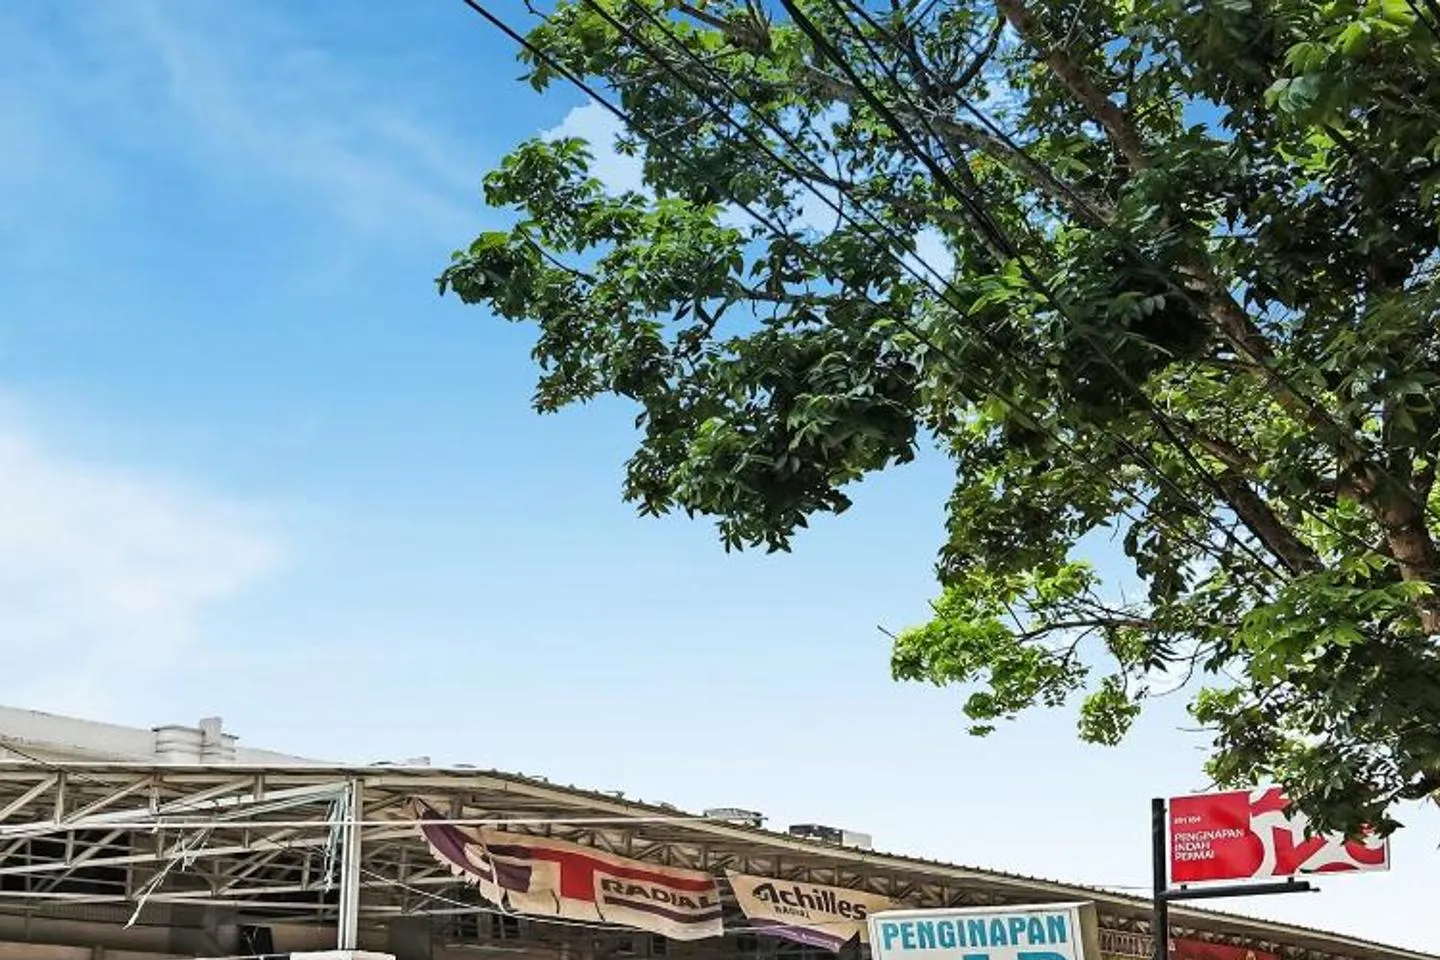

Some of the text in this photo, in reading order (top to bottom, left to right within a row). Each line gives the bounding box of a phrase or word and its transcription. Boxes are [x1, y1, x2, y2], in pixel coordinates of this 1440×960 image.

[1174, 828, 1245, 842] PENGINAPAN
[1174, 841, 1210, 852] INDAH
[601, 878, 718, 908] RADIAL
[753, 883, 867, 920] Achilles
[881, 915, 1067, 950] PENGINAPAN
